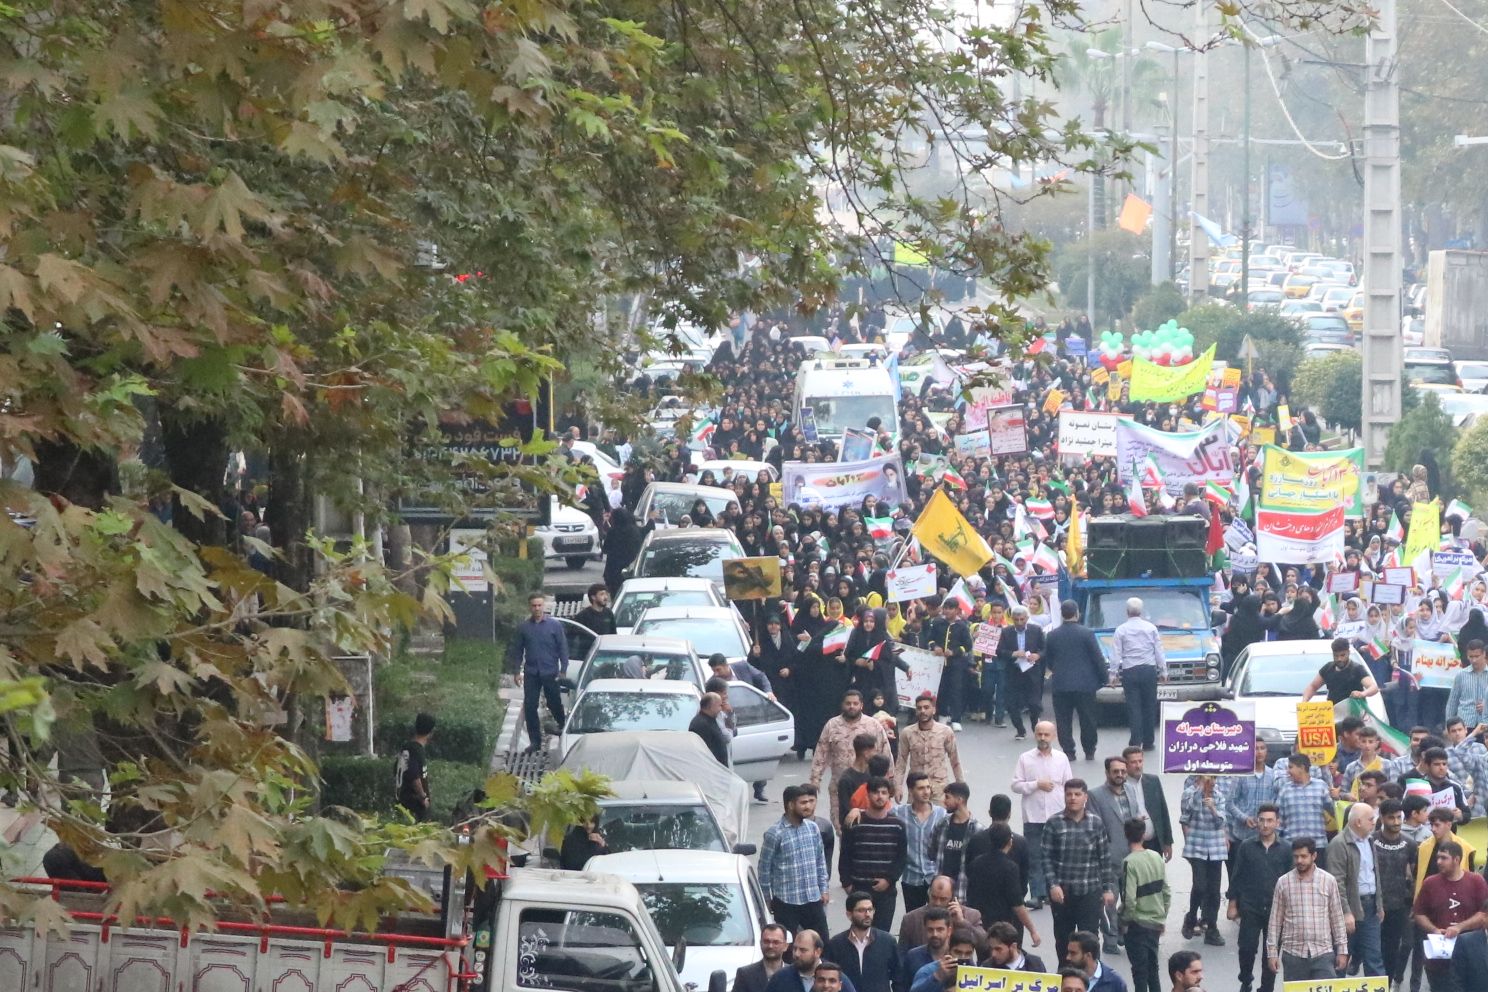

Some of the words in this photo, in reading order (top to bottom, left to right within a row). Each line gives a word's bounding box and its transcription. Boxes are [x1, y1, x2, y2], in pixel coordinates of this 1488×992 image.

[1176, 722, 1203, 736] پسرانه
[1203, 722, 1242, 737] دبیرستان
[1303, 732, 1331, 746] USA
[1169, 740, 1197, 753] درازان
[1200, 740, 1227, 754] فلاحی
[1228, 741, 1250, 753] شهید
[1184, 759, 1200, 771] اول
[1202, 760, 1233, 772] متوسطه
[959, 974, 1006, 991] اسرائیل
